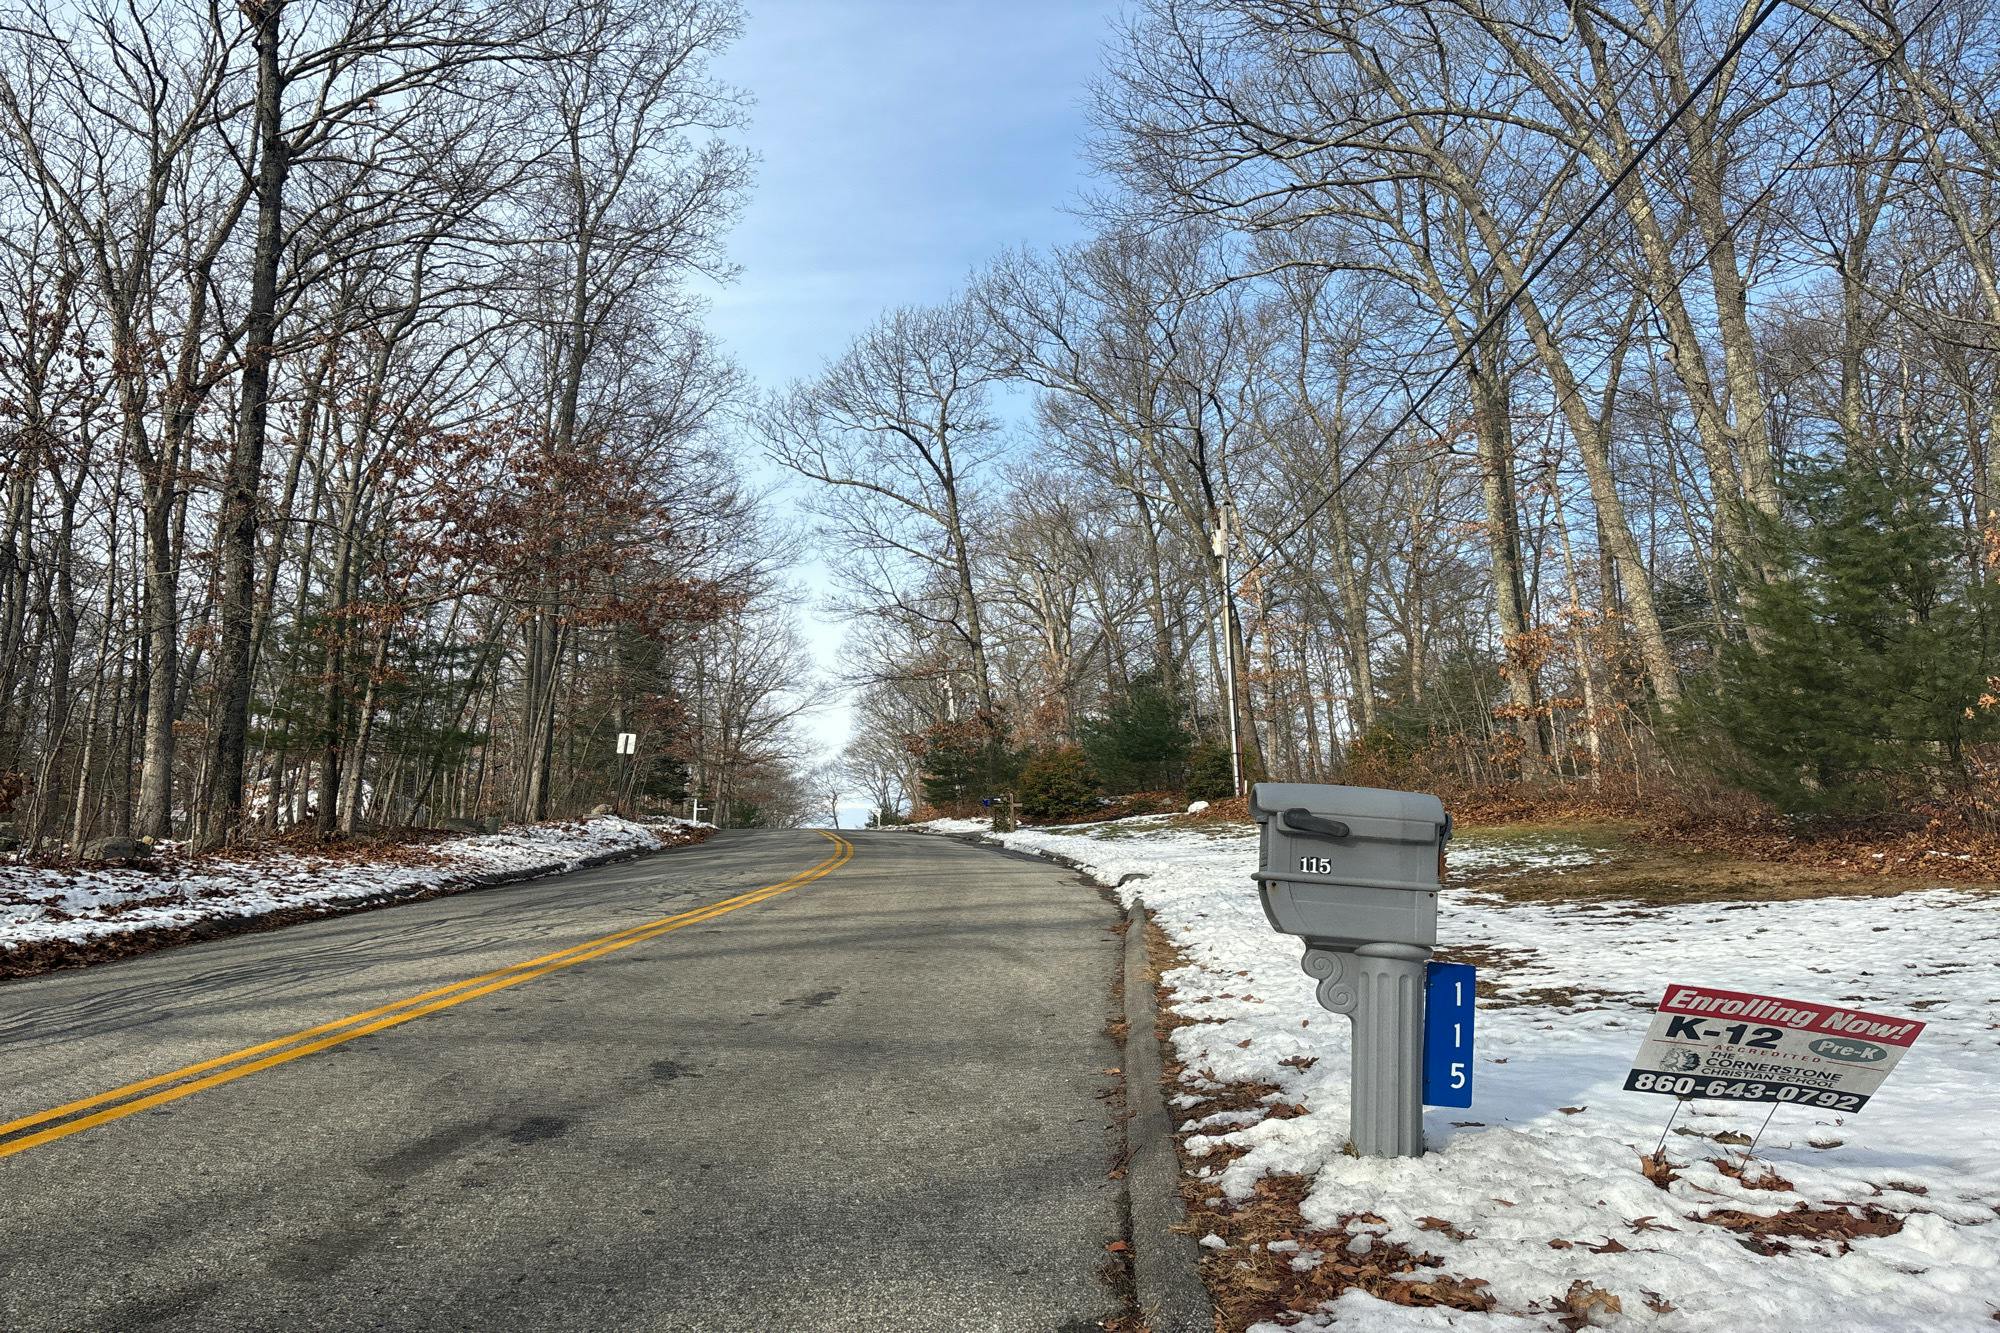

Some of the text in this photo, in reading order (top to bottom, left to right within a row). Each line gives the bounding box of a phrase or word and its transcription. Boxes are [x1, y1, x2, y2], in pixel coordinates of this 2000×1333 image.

[1300, 857, 1331, 874] 115
[1667, 989, 1916, 1040] Enrolling Now!
[1665, 1015, 1783, 1050] K-12
[1711, 1051, 1735, 1060] THE
[1714, 1044, 1821, 1063] ACCREDITED
[1817, 1040, 1880, 1060] Pre-K
[1701, 1068, 1837, 1089] CHRISTIAN SCHOOL
[1706, 1058, 1843, 1082] CORNERSTONE
[1634, 1073, 1860, 1111] 860-643-0792
